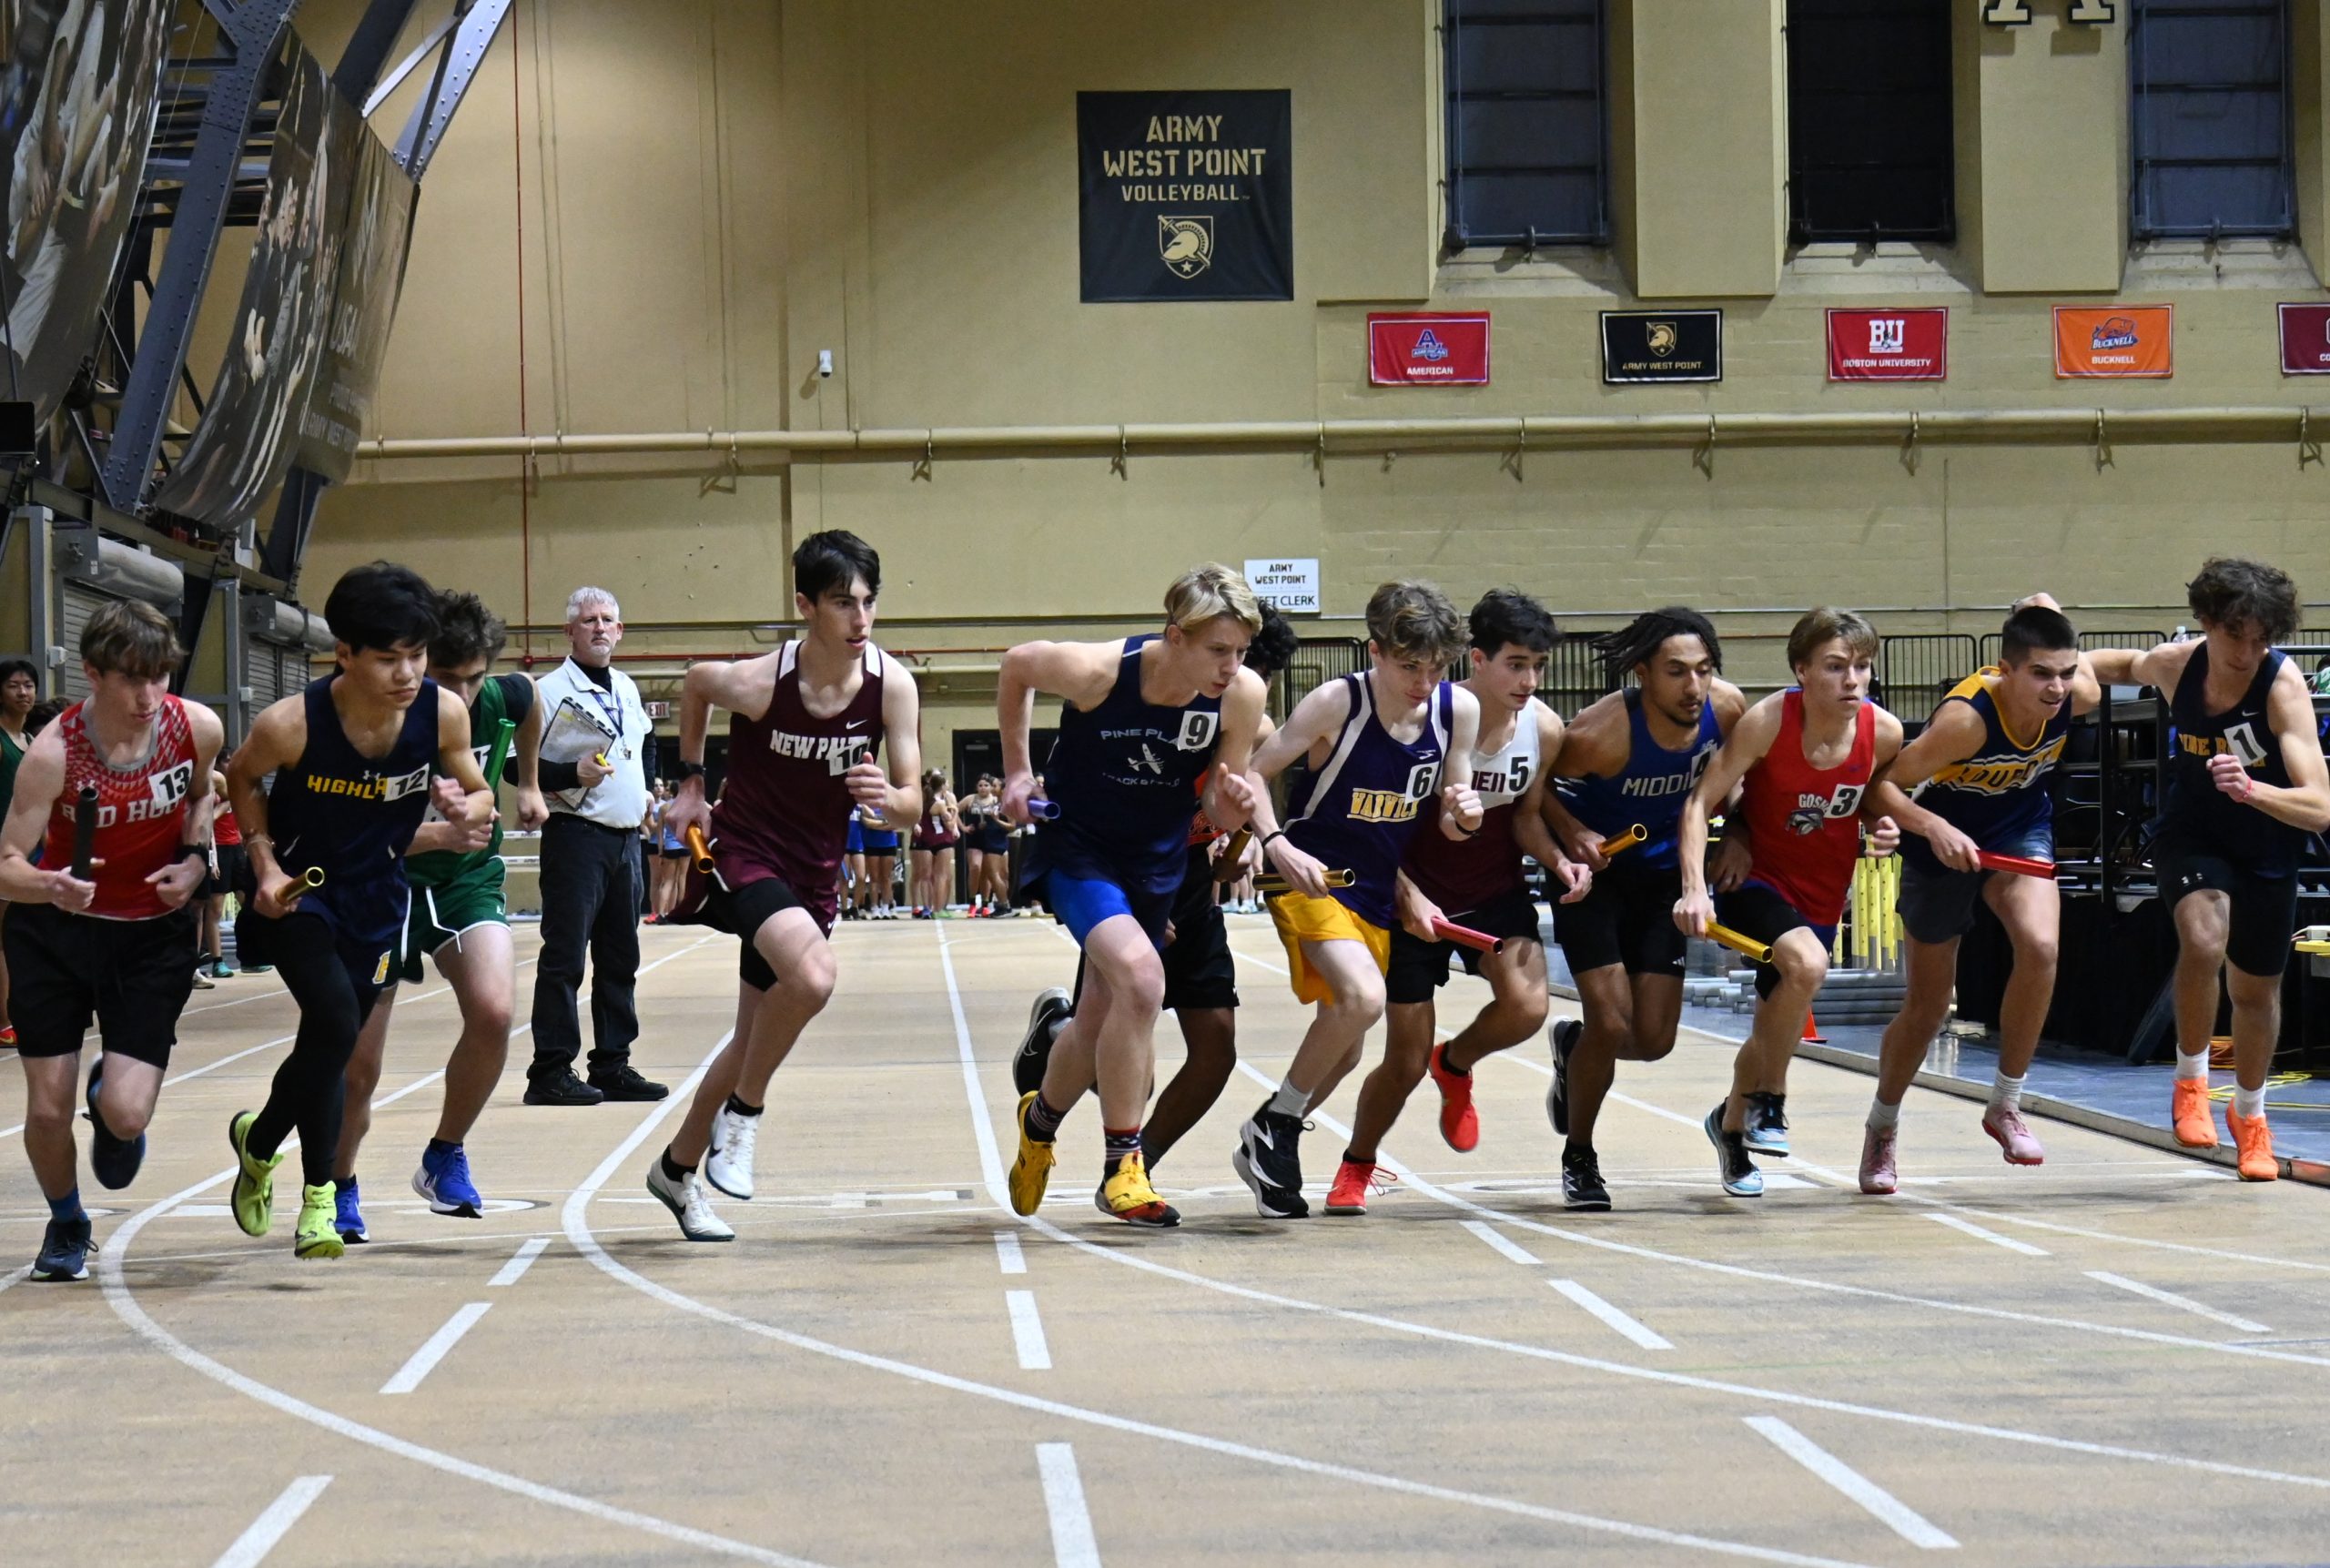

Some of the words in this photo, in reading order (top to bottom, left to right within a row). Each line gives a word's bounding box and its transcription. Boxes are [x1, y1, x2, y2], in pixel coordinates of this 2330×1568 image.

[1146, 116, 1222, 142] ARMY
[1103, 149, 1180, 177] WEST
[1188, 148, 1267, 176] POINT
[1121, 184, 1240, 201] VOLLEYBALL
[1869, 319, 1905, 347] BU
[2093, 336, 2134, 349] BUCKNELL
[1406, 367, 1454, 375] AMERICAN
[1622, 362, 1647, 370] ARMY
[1649, 362, 1673, 370] WEST
[1675, 361, 1702, 369] POINT
[1843, 359, 1877, 368] BOSTON
[1879, 359, 1931, 367] UNIVERSITY
[2092, 355, 2135, 364] BUCKNELL
[1255, 575, 1279, 584] WEST
[1282, 575, 1306, 584] POINT
[1270, 564, 1292, 572] ARMY
[1281, 596, 1315, 606] CLERK
[1100, 729, 1142, 740] PINE
[1186, 714, 1210, 746] 9
[770, 729, 816, 759] NEW
[2234, 728, 2258, 761] 1
[159, 766, 190, 801] 13
[308, 774, 388, 799] HIGHLA
[394, 769, 426, 797] 12
[1413, 766, 1432, 798] 6
[1509, 756, 1529, 792] 5
[1830, 788, 1857, 815] 3
[62, 803, 116, 828] RD
